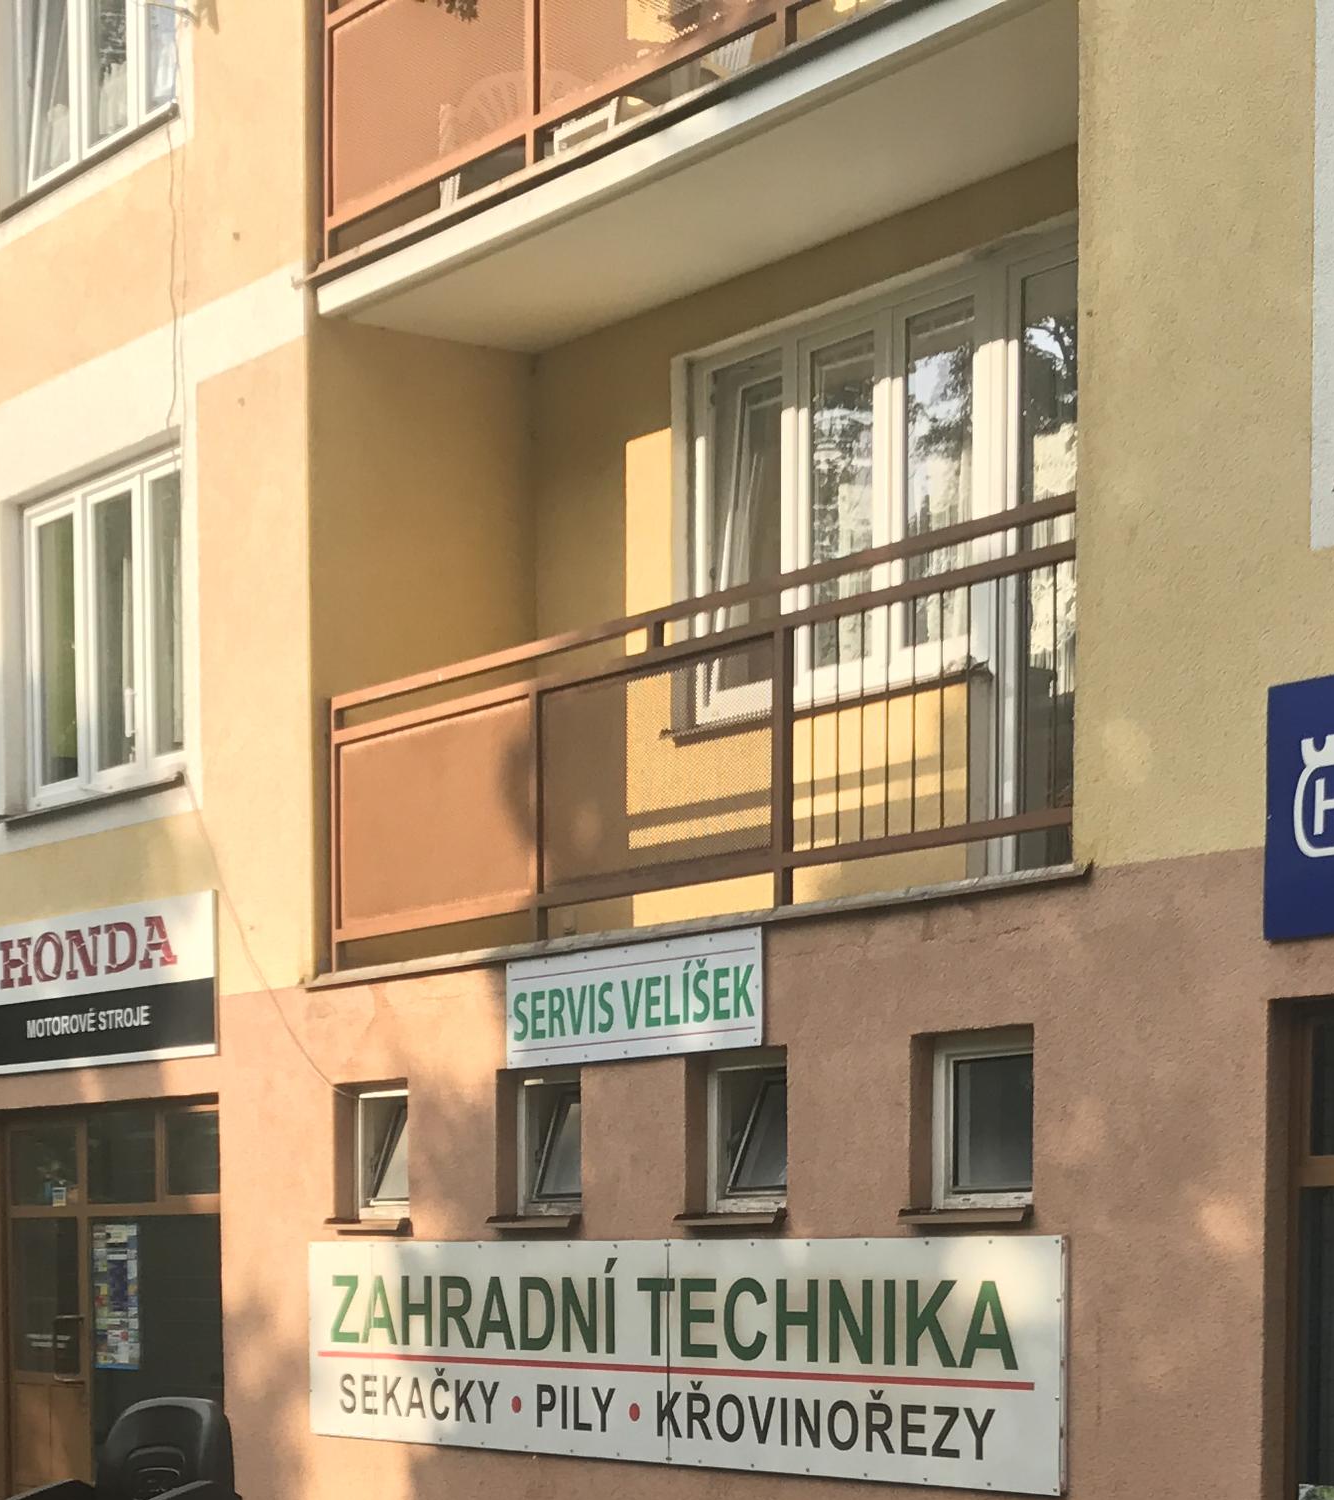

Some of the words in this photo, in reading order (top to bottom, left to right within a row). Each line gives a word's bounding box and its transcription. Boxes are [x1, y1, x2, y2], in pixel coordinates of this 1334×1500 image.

[26, 1008, 96, 1039] MOTOROVÉ
[98, 1005, 151, 1032] STROJE
[512, 980, 615, 1043] SERVIS
[620, 957, 756, 1031] VELÍŠEK
[330, 1257, 618, 1355] ZAHRADNÍ
[637, 1276, 1019, 1371] TECHNIKA
[339, 1367, 500, 1425] SEKAČKY
[535, 1383, 617, 1434] PILY
[656, 1380, 996, 1462] KŘOVINOŘEZY
